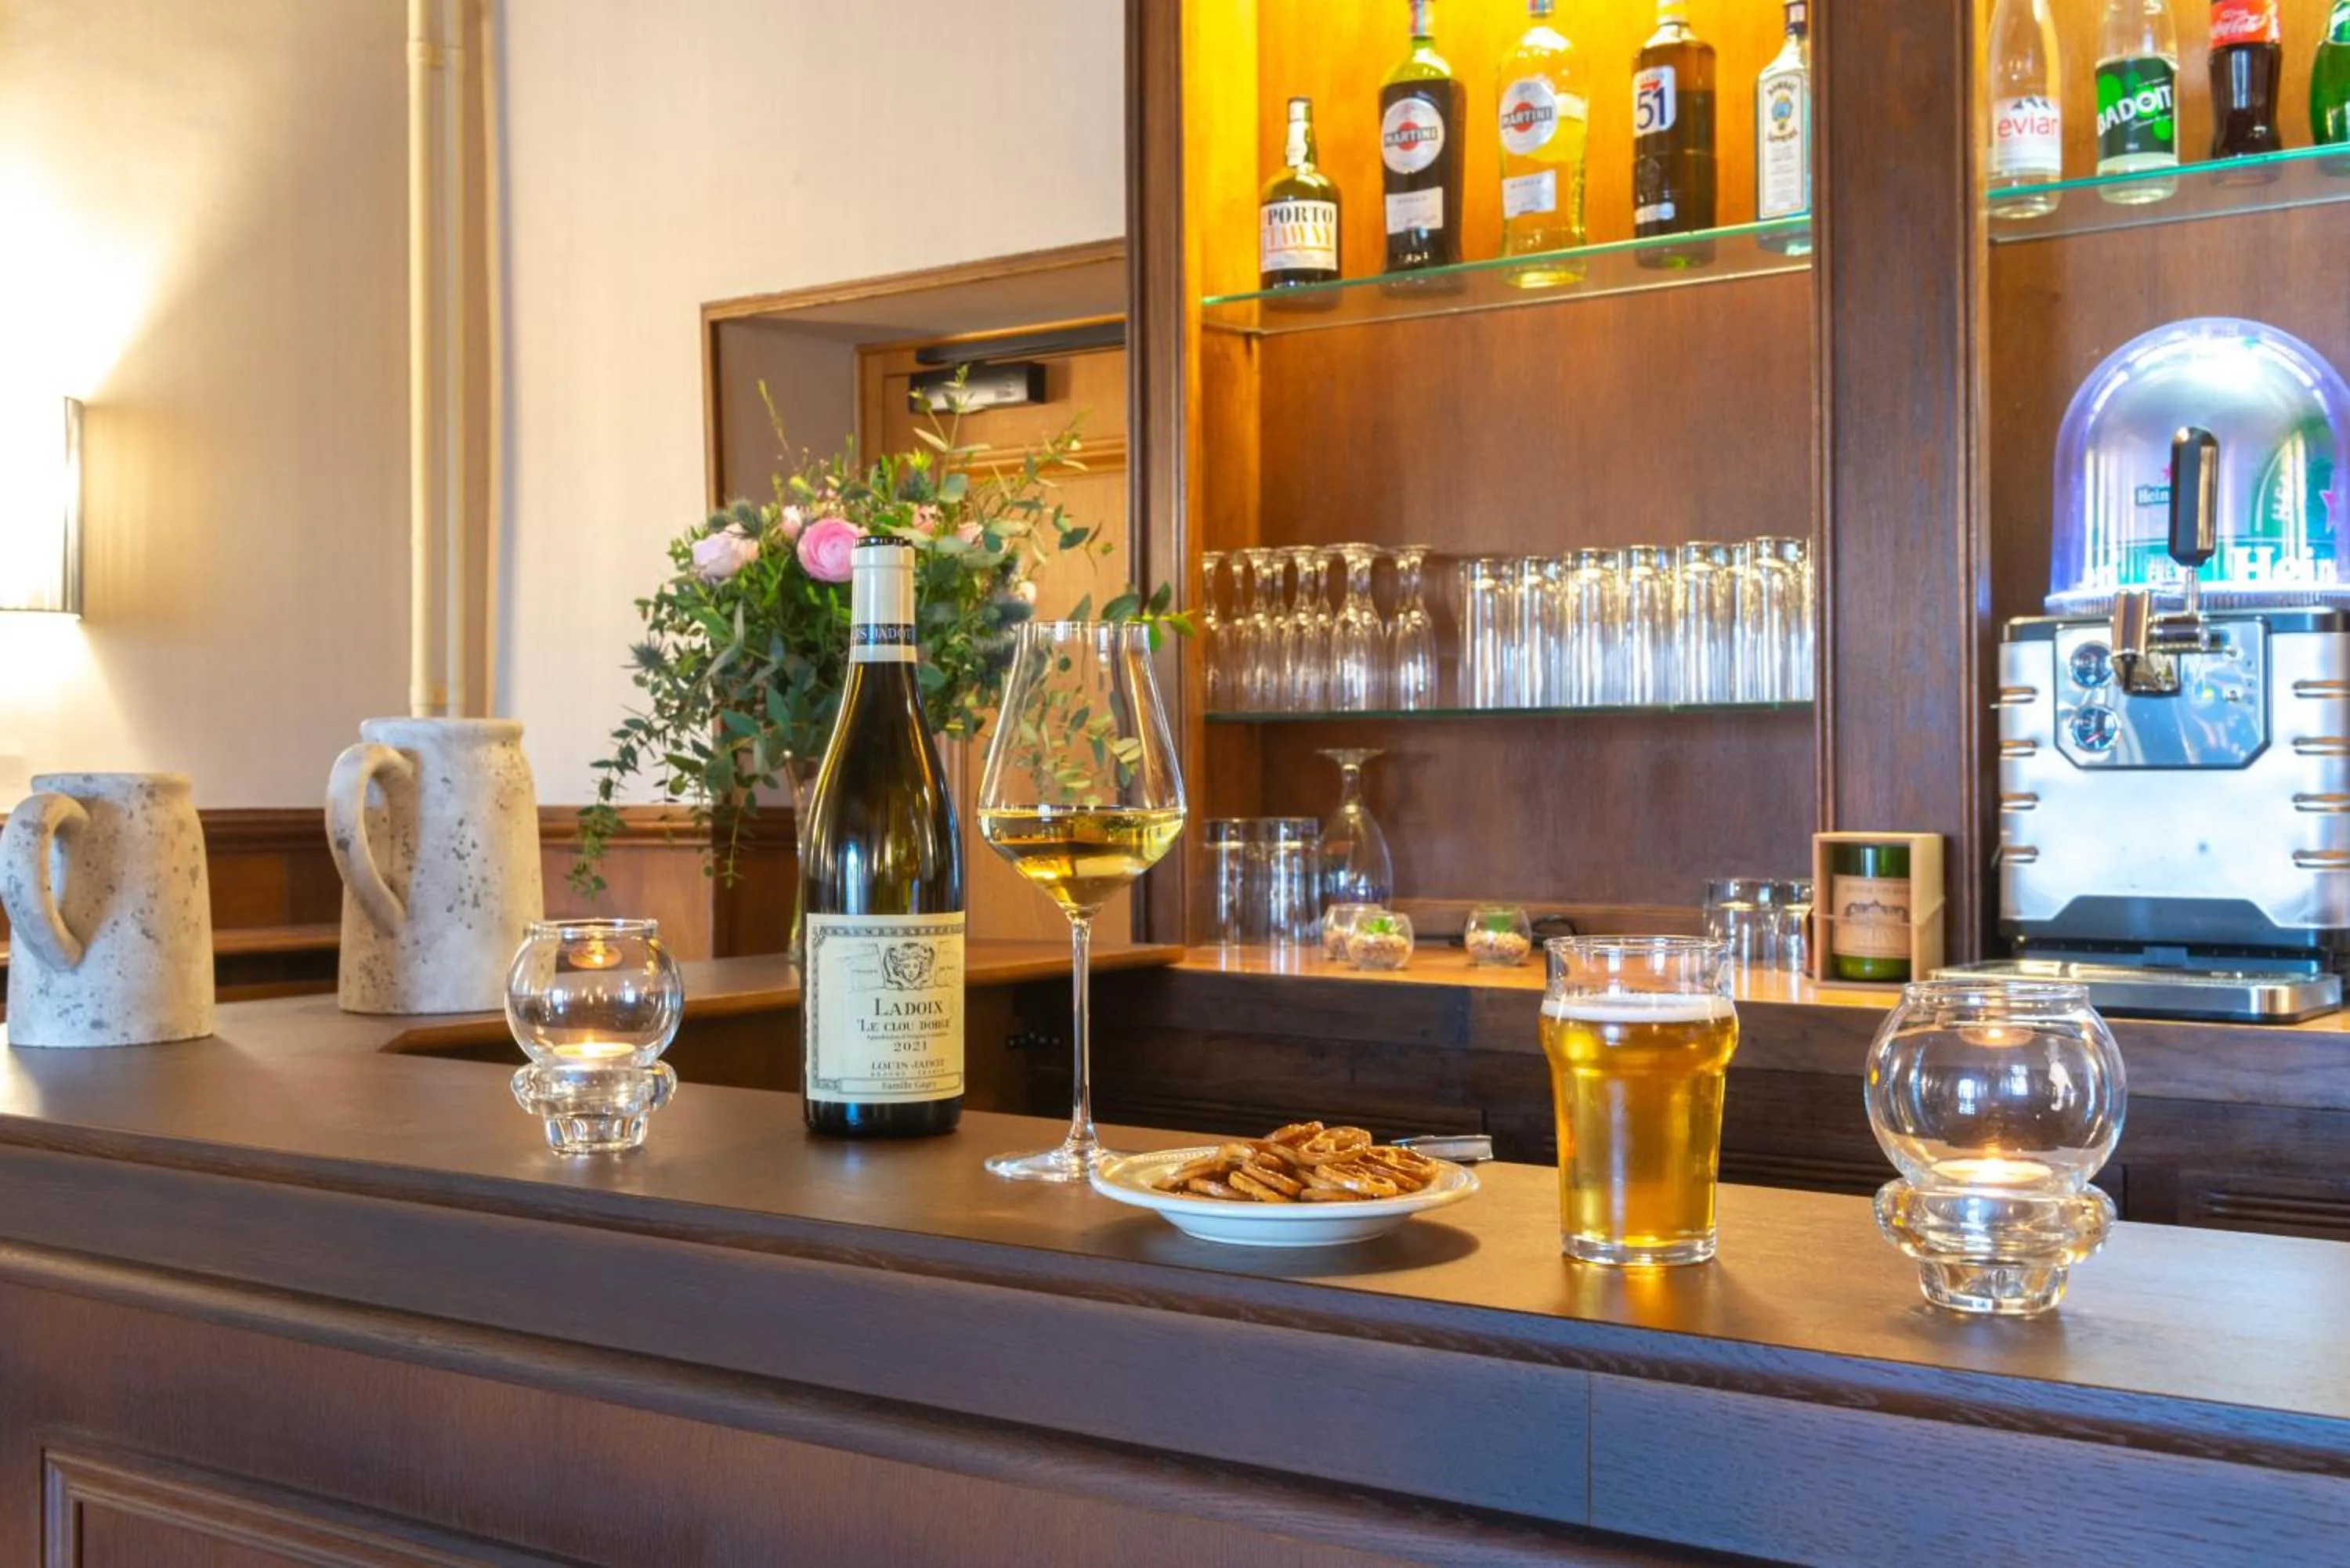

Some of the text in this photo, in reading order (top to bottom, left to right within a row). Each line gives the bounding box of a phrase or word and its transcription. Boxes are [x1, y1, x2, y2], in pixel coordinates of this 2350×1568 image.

[1501, 106, 1553, 129] MARTINI
[1636, 87, 1667, 130] 51
[2098, 85, 2172, 137] BADOIT
[1383, 126, 1438, 147] MARTINI
[1267, 206, 1333, 226] PORTO
[874, 997, 944, 1016] LADOIX
[893, 1041, 927, 1052] 2021
